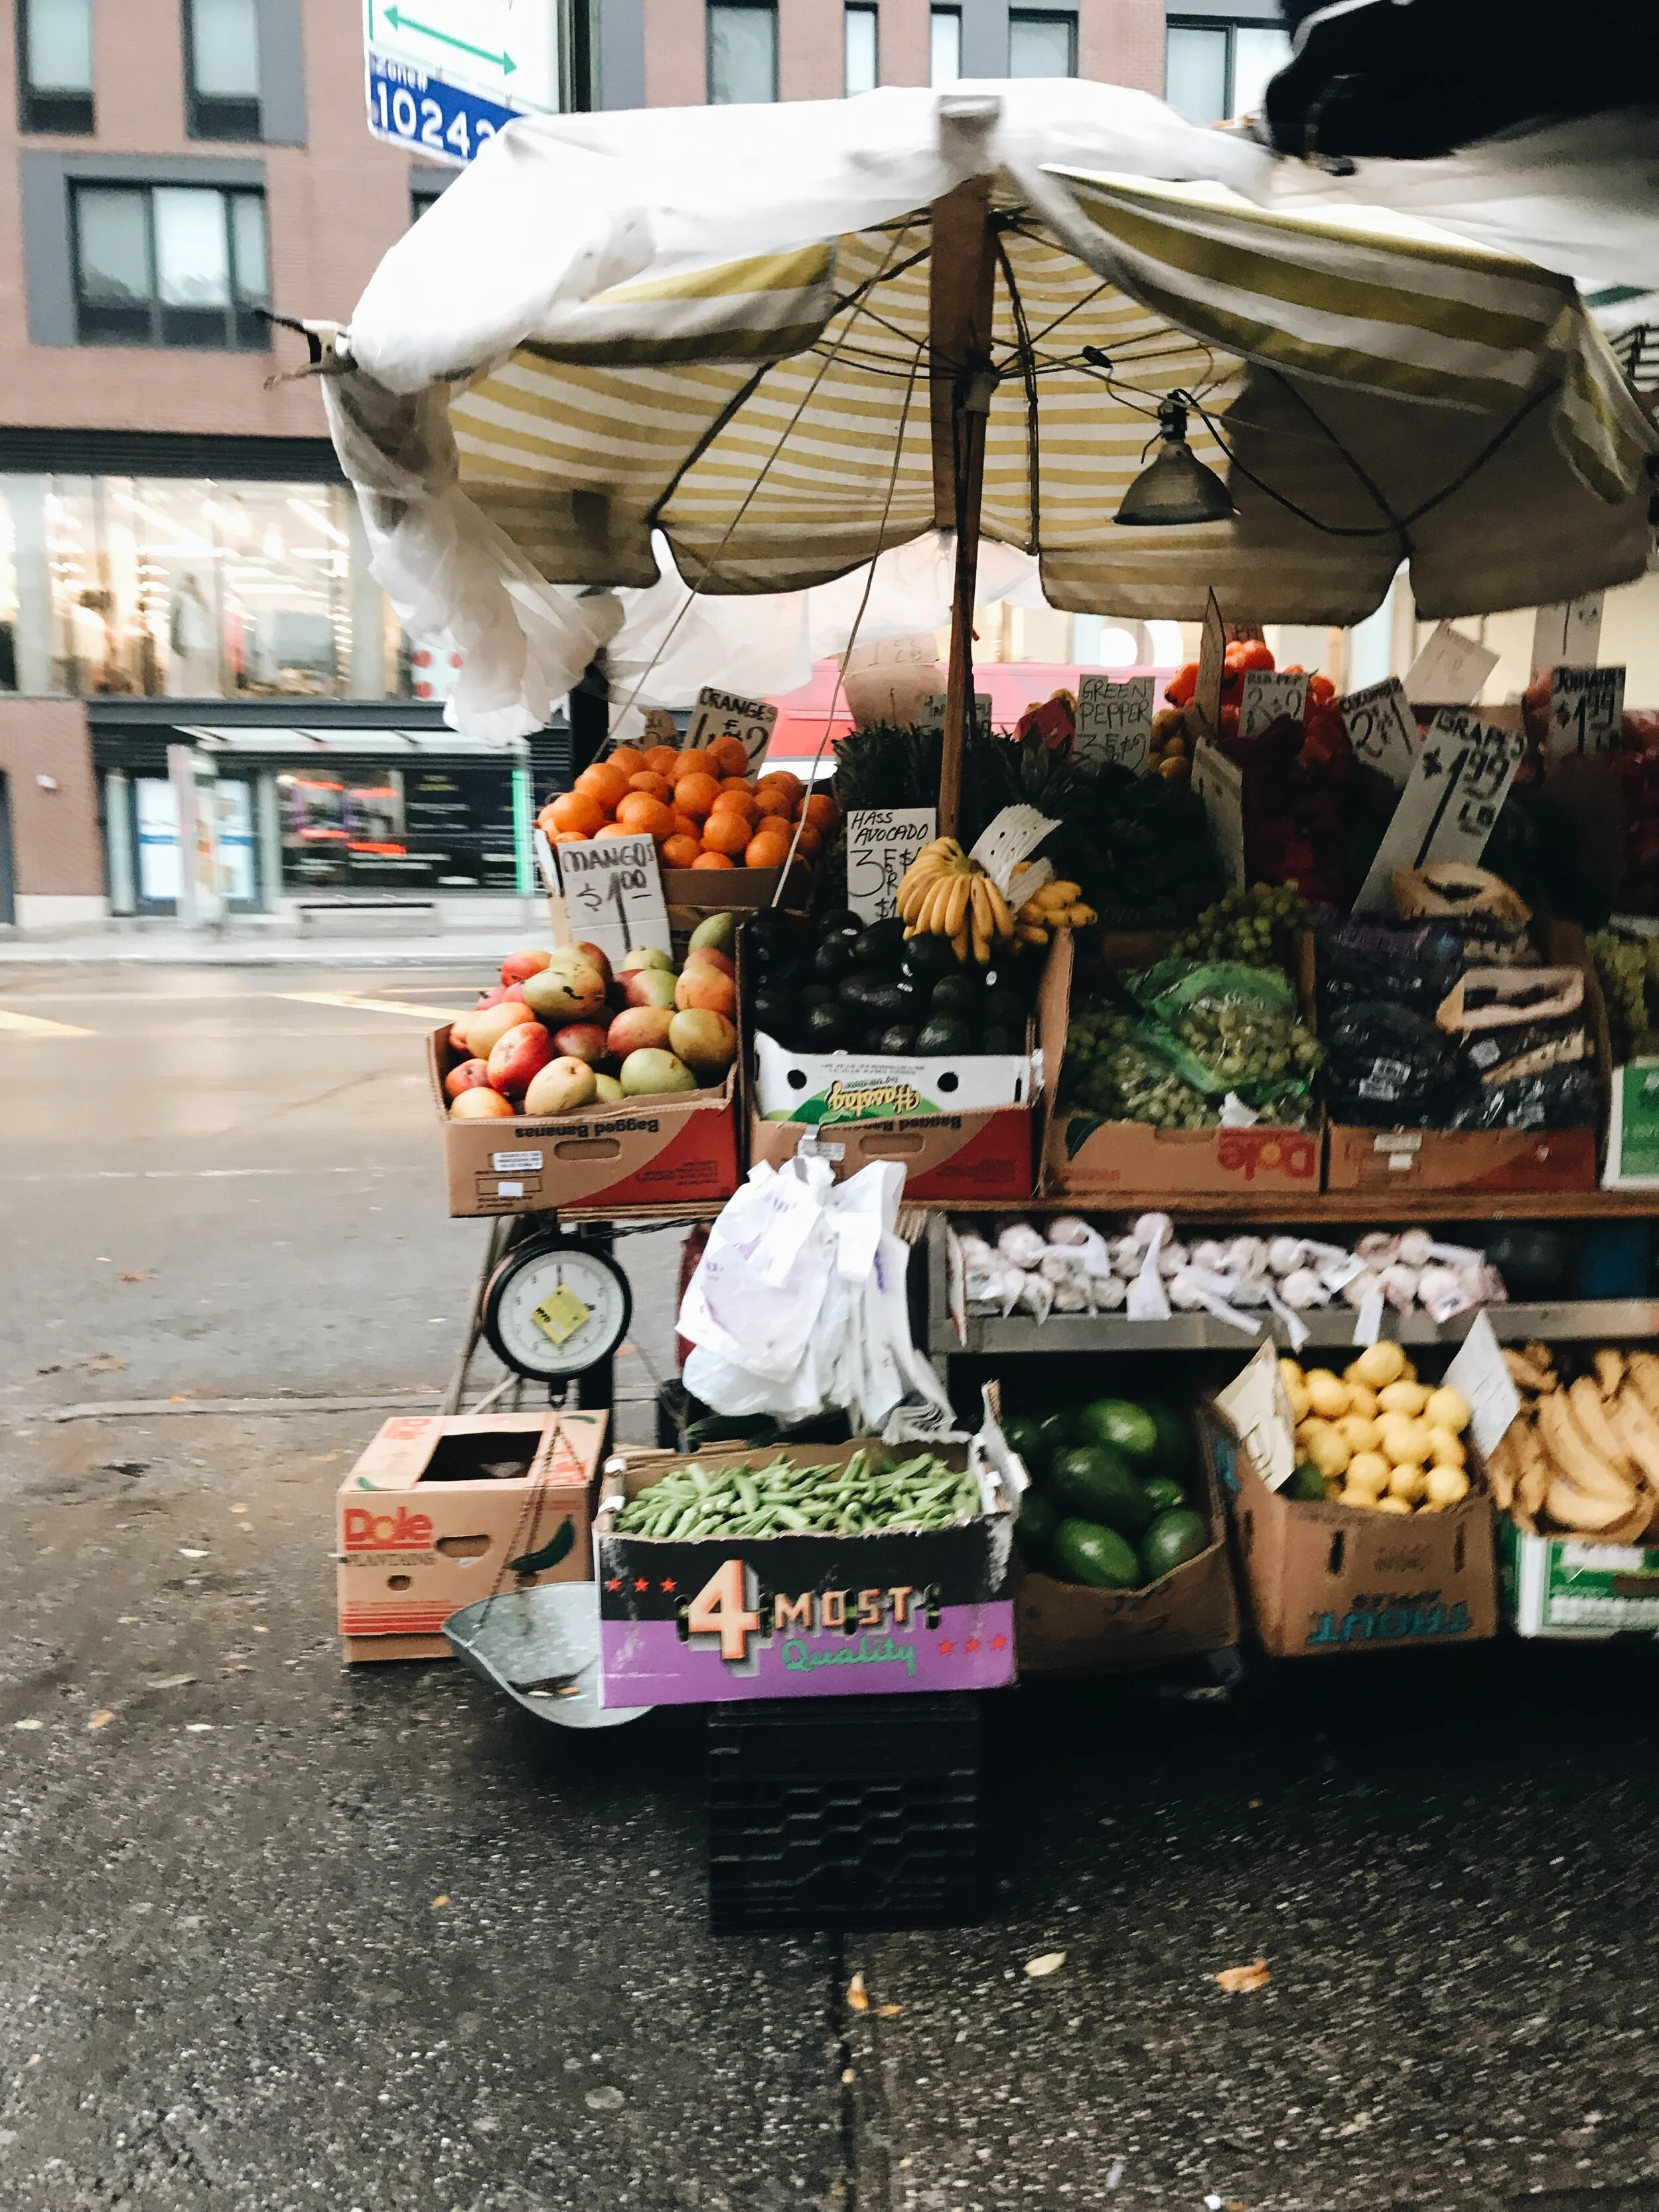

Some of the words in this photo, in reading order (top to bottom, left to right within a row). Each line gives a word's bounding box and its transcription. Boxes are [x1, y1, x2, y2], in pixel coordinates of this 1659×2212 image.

[1083, 678, 1147, 702] GREEN
[1080, 699, 1153, 731] PEPPER
[851, 811, 894, 830] HASS
[854, 823, 929, 846] AVOCADO
[848, 849, 885, 897] 3
[515, 1125, 590, 1140] Bananas
[594, 1118, 660, 1136] Bagged
[1217, 1130, 1316, 1181] Dole
[344, 1506, 433, 1543] Dole
[687, 1559, 760, 1660] 4
[774, 1585, 914, 1630] MOST
[781, 1635, 916, 1678] Quality
